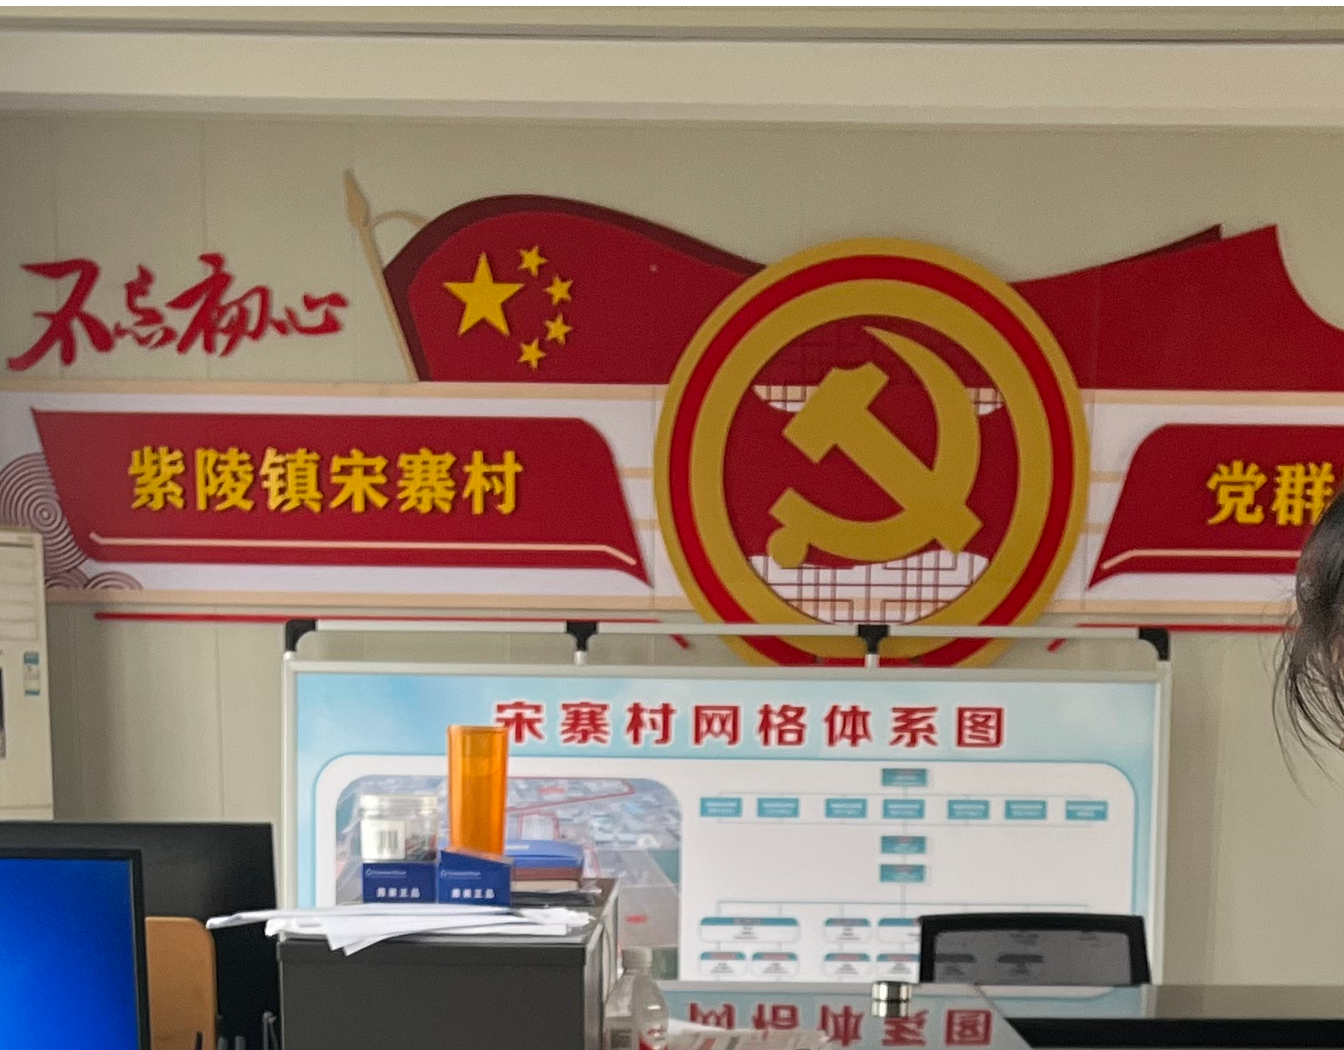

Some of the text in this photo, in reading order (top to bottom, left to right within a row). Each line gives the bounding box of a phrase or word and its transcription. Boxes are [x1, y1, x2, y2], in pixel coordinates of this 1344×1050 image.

[7, 253, 349, 371] 不忘初心
[127, 446, 524, 516] 紫陵镇宋寨村
[495, 701, 1005, 748] 宋寨村网格体系图
